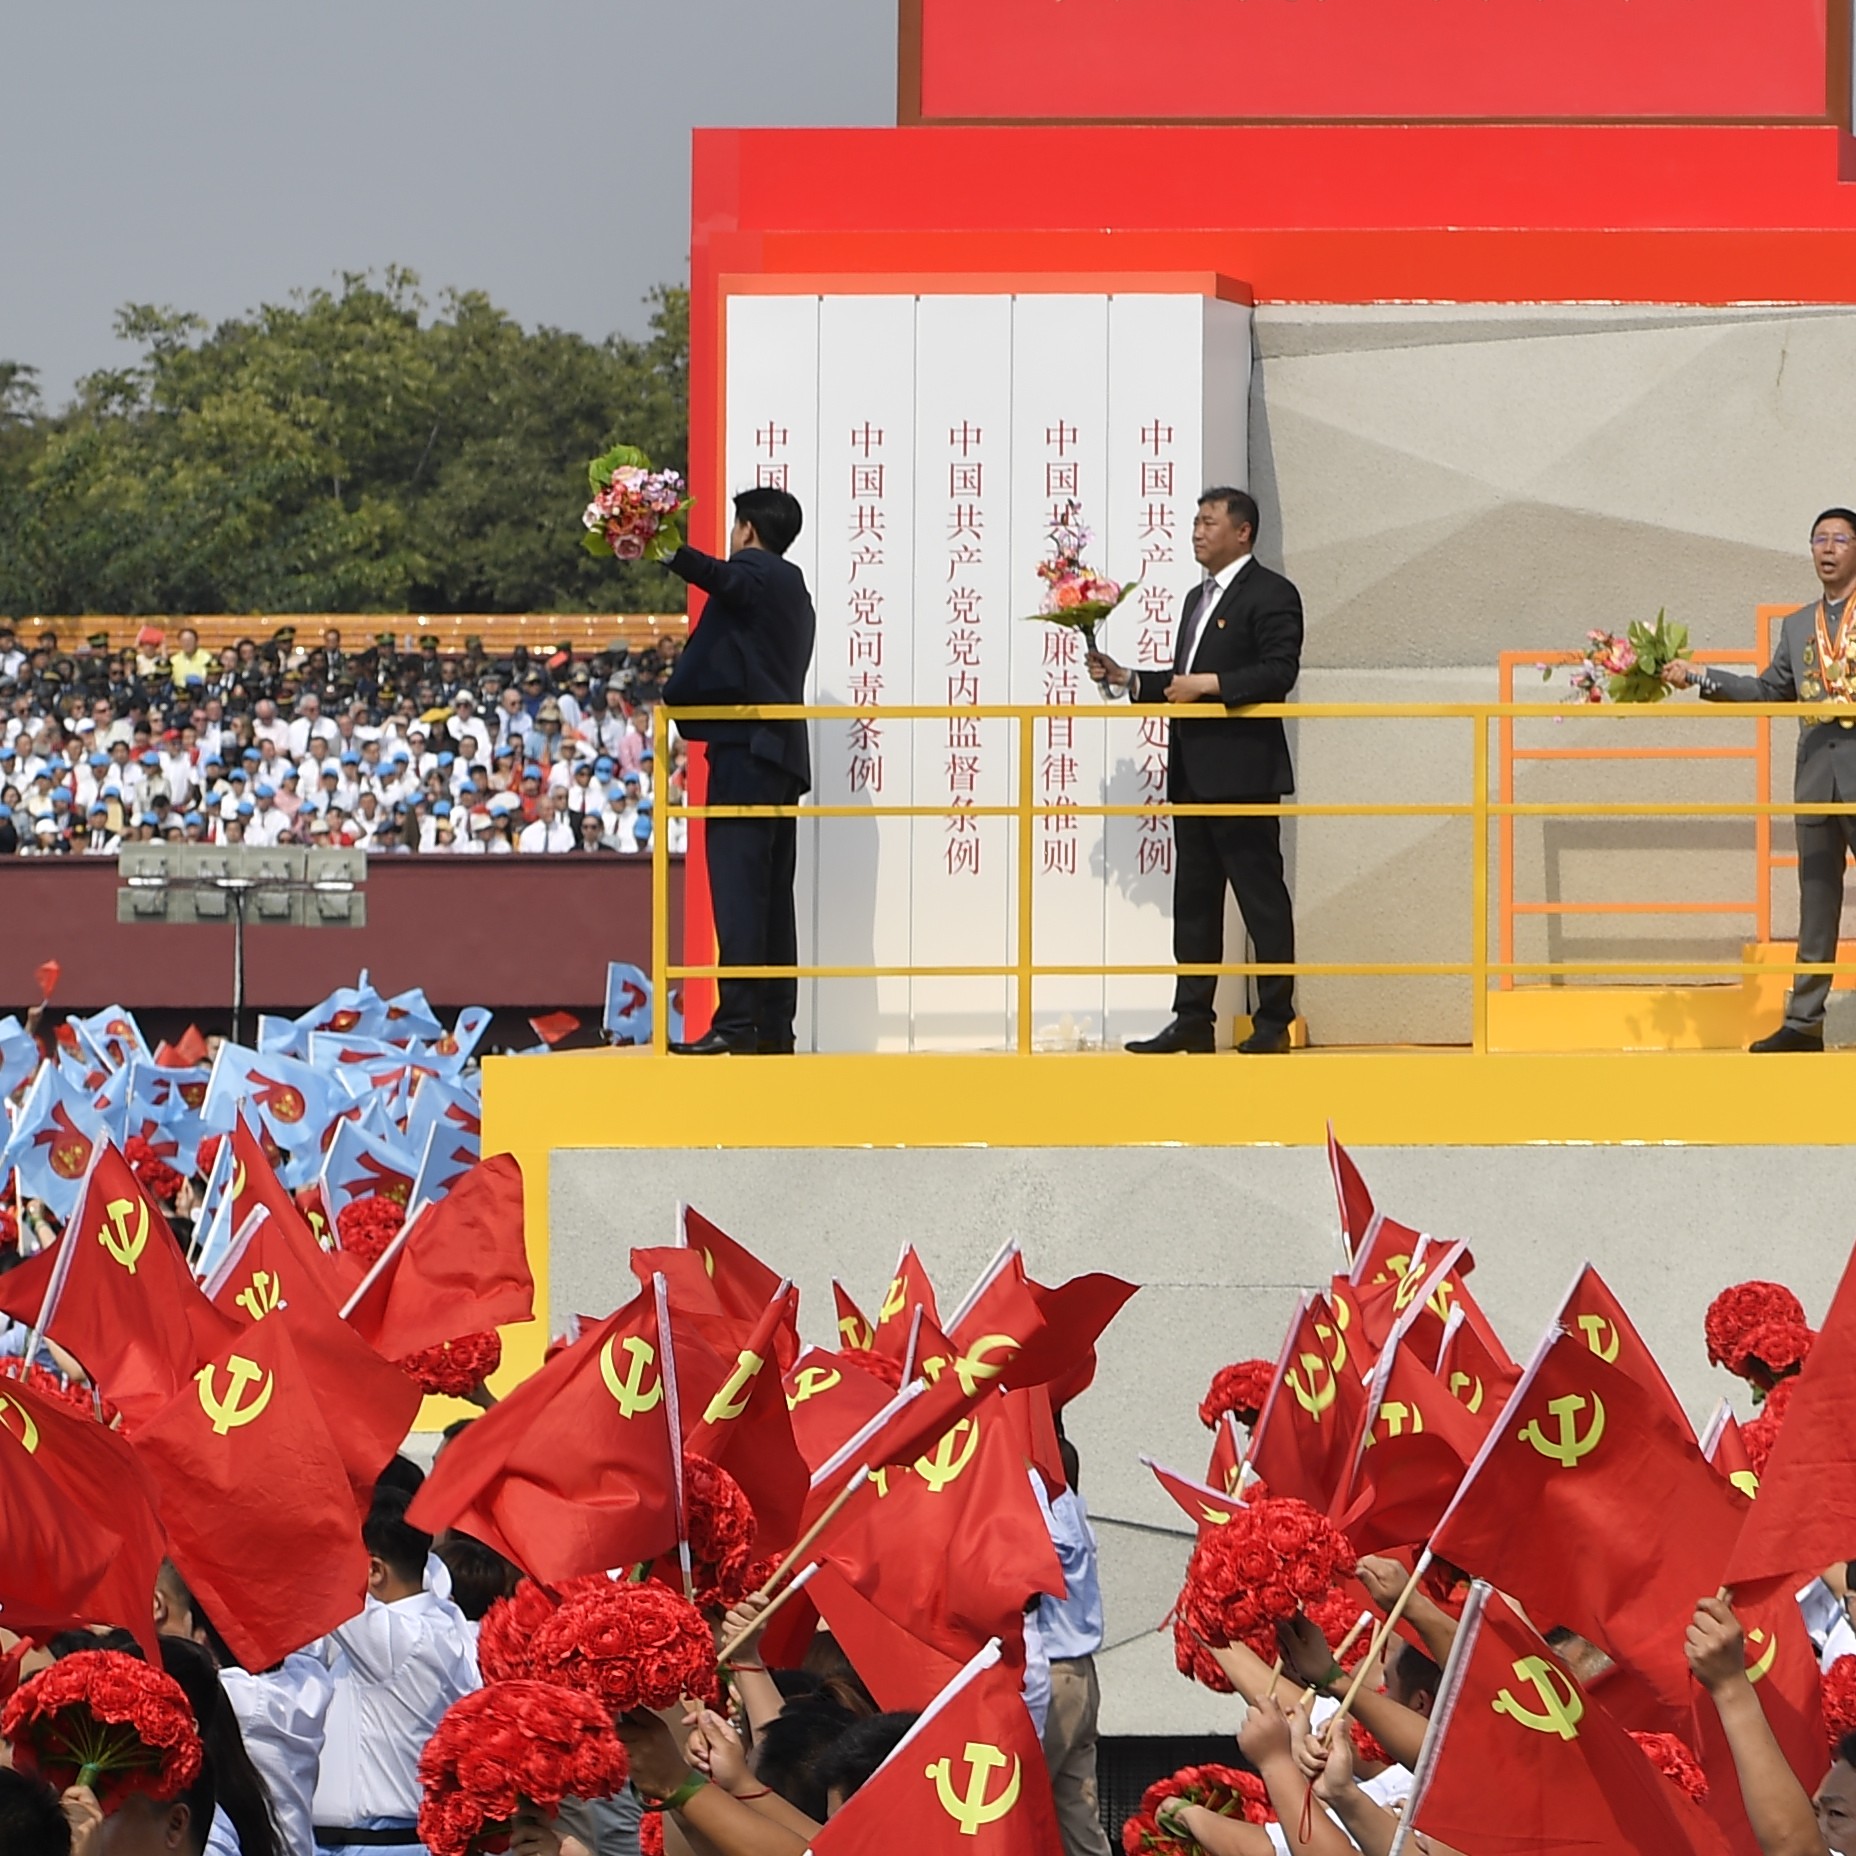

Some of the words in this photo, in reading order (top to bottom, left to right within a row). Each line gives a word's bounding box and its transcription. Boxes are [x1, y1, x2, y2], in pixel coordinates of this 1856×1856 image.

[847, 421, 886, 793] 中国共产党问责条例
[943, 419, 985, 876] 中国共产党党内监督条例
[1041, 419, 1081, 876] 中国共廉洁自律准则
[1135, 418, 1176, 876] 中国共产党纪处分条例
